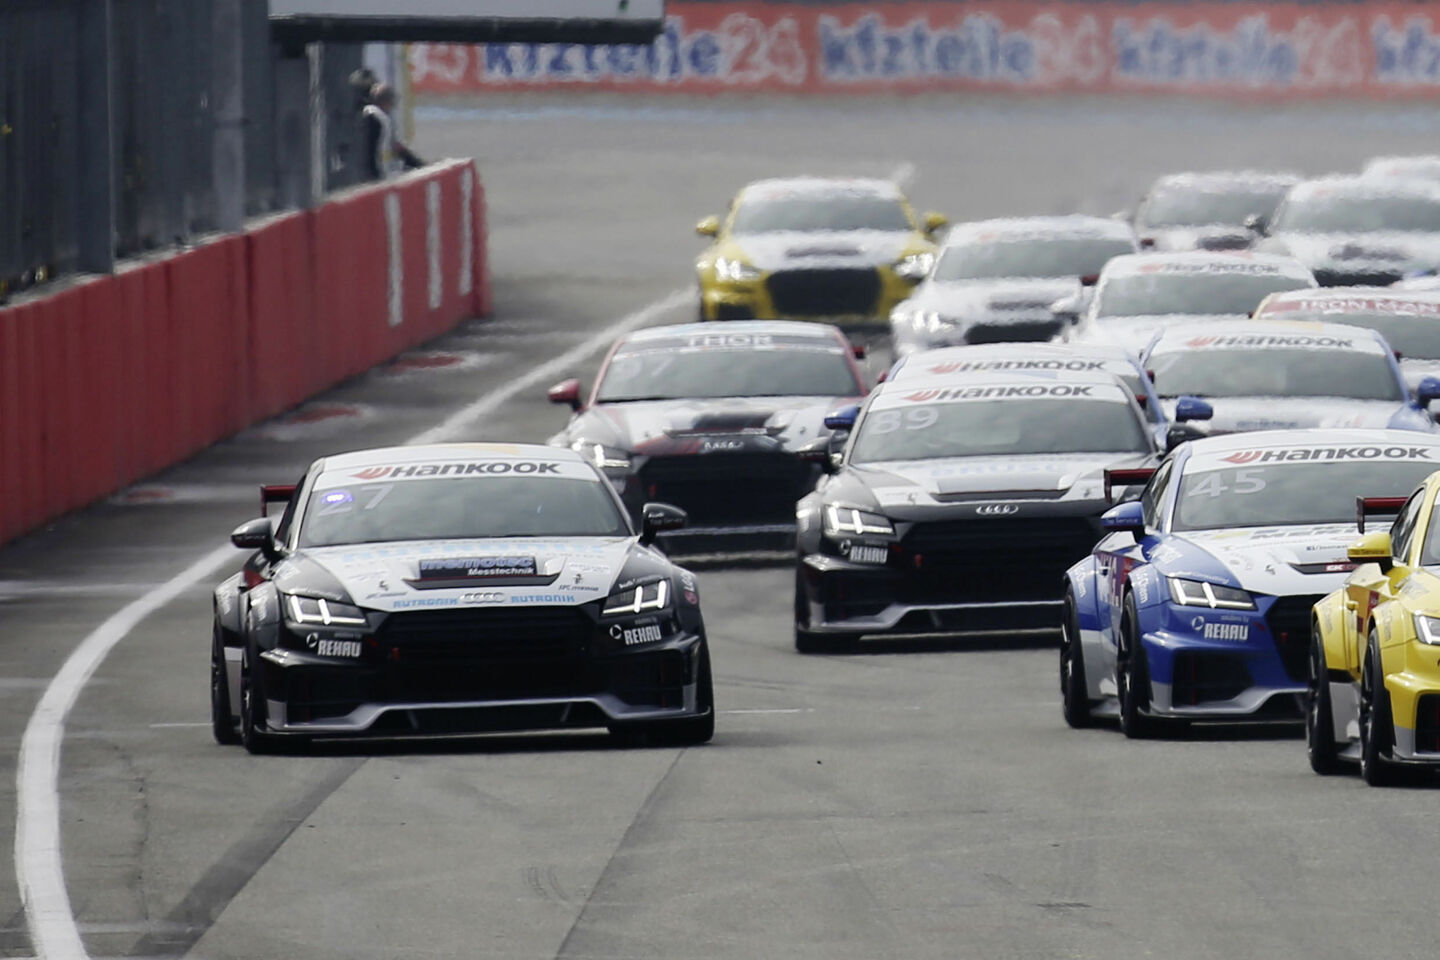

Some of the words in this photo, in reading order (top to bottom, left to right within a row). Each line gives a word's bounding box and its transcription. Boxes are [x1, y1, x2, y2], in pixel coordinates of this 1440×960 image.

[1187, 468, 1267, 497] 45
[467, 567, 535, 576] Messtechnik
[623, 624, 662, 646] REHAU
[1203, 623, 1249, 641] REHAU
[318, 640, 362, 658] REHAU
